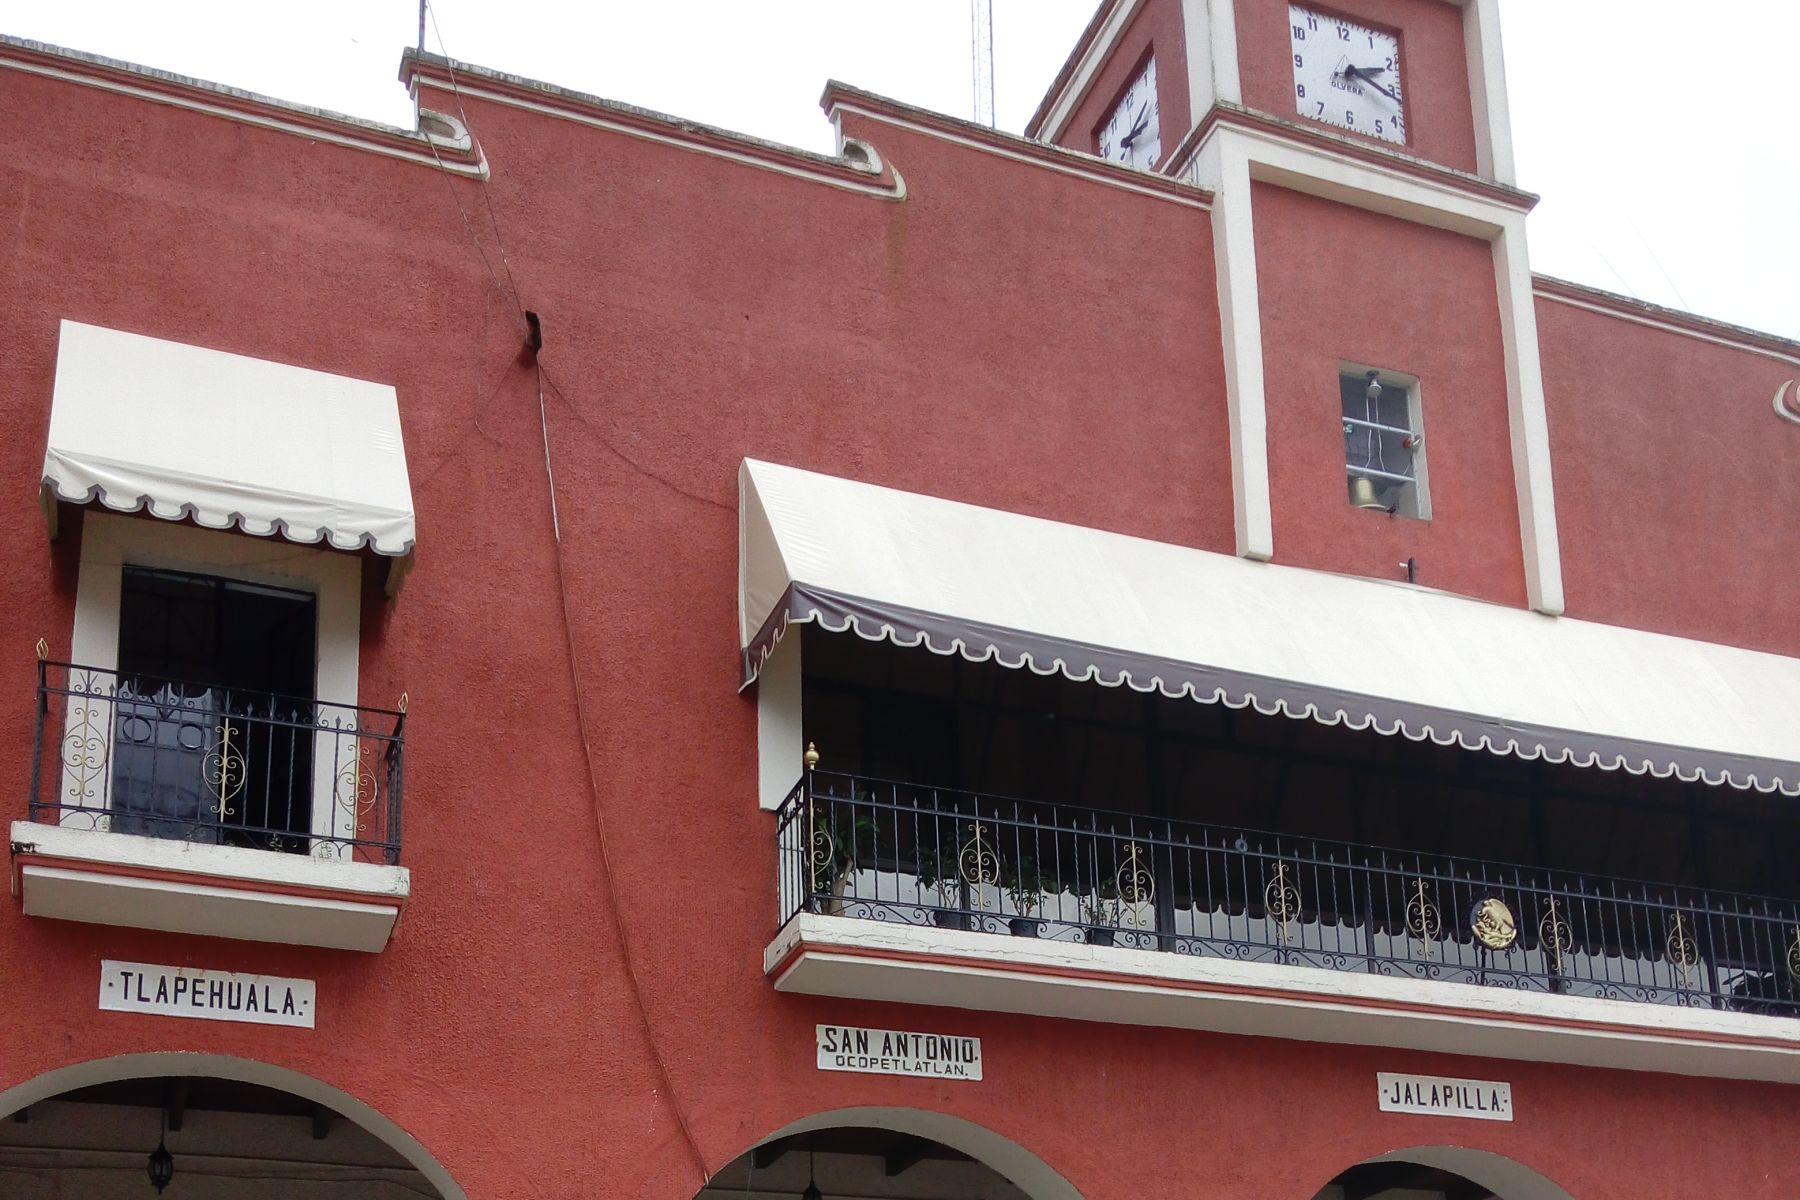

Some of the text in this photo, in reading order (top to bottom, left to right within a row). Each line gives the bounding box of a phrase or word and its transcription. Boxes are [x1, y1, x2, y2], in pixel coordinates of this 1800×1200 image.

[1307, 17, 1318, 31] 11
[1292, 26, 1305, 40] 10
[1336, 26, 1350, 41] 12
[1368, 36, 1373, 49] 1
[1294, 54, 1303, 68] 9
[1386, 57, 1393, 71] 2
[1297, 84, 1306, 98] 8
[1316, 101, 1325, 115] 7
[1346, 110, 1354, 125] 6
[1391, 115, 1397, 128] 4
[1375, 119, 1383, 133] 5
[822, 1027, 868, 1055] SAN
